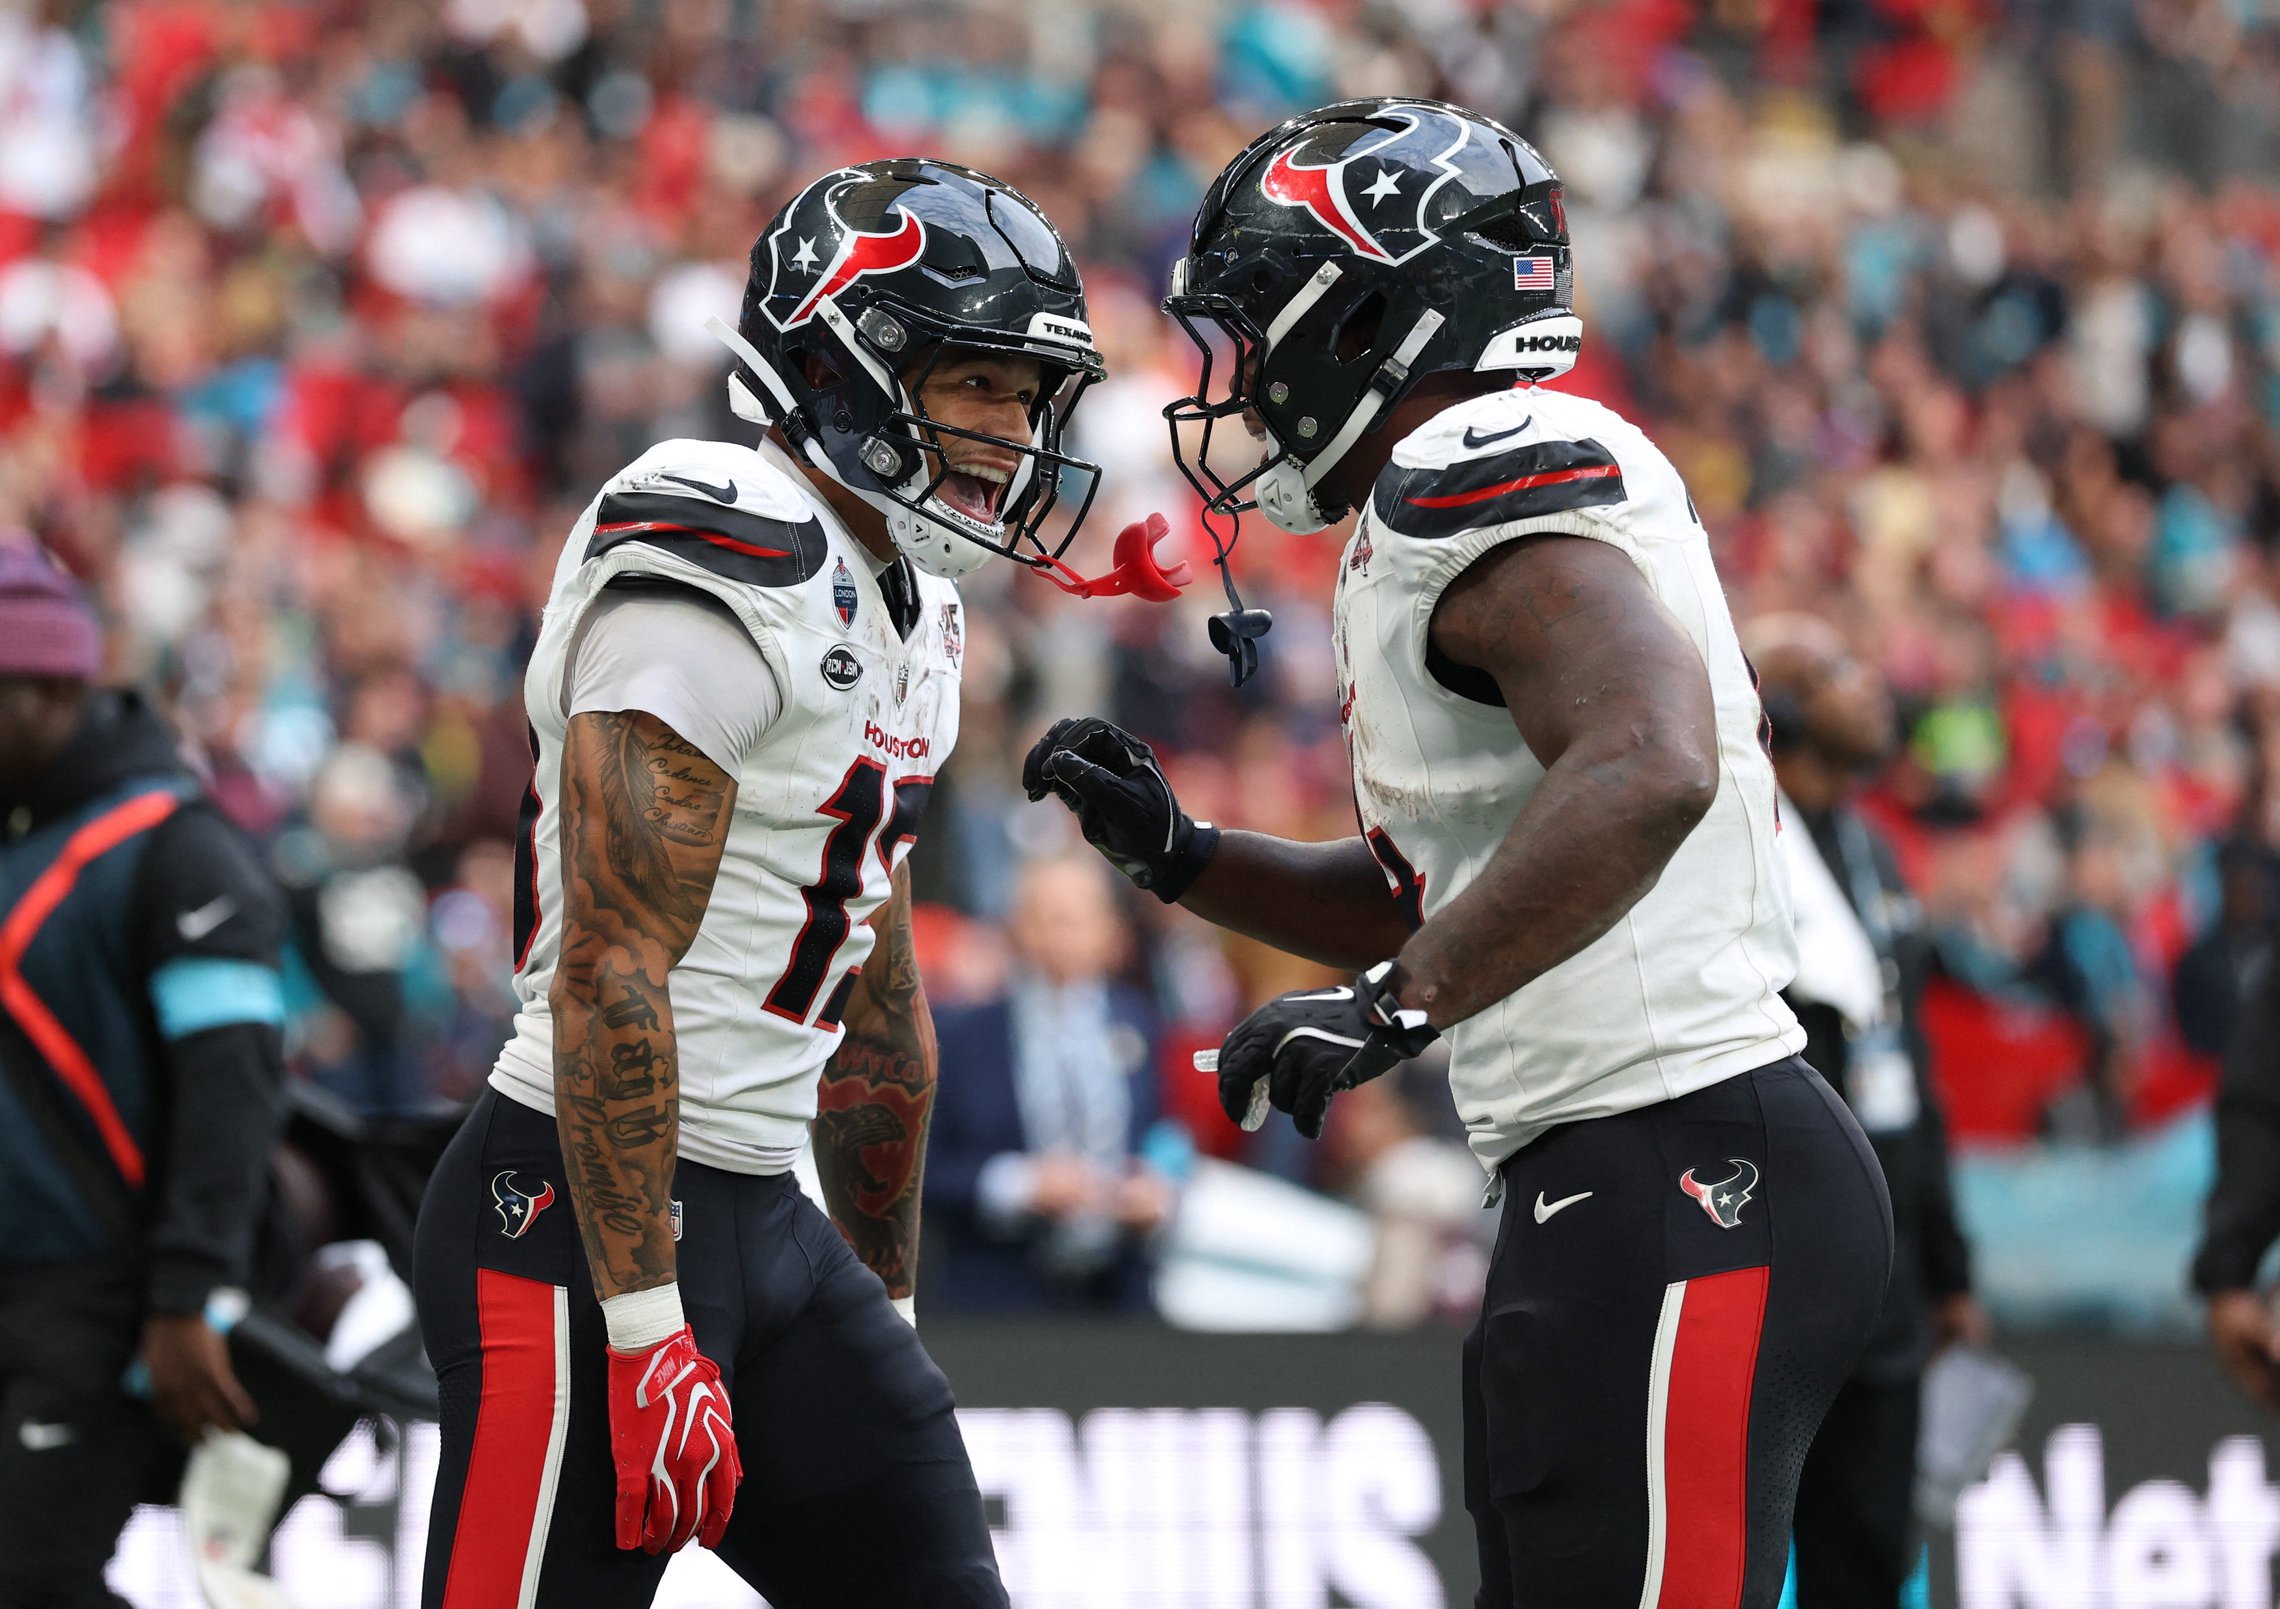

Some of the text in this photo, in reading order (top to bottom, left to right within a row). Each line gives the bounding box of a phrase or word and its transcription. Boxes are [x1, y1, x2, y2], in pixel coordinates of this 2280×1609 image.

[834, 588, 856, 599] LONDON
[864, 719, 931, 761] HOUSTON
[602, 984, 674, 1150] Faith
